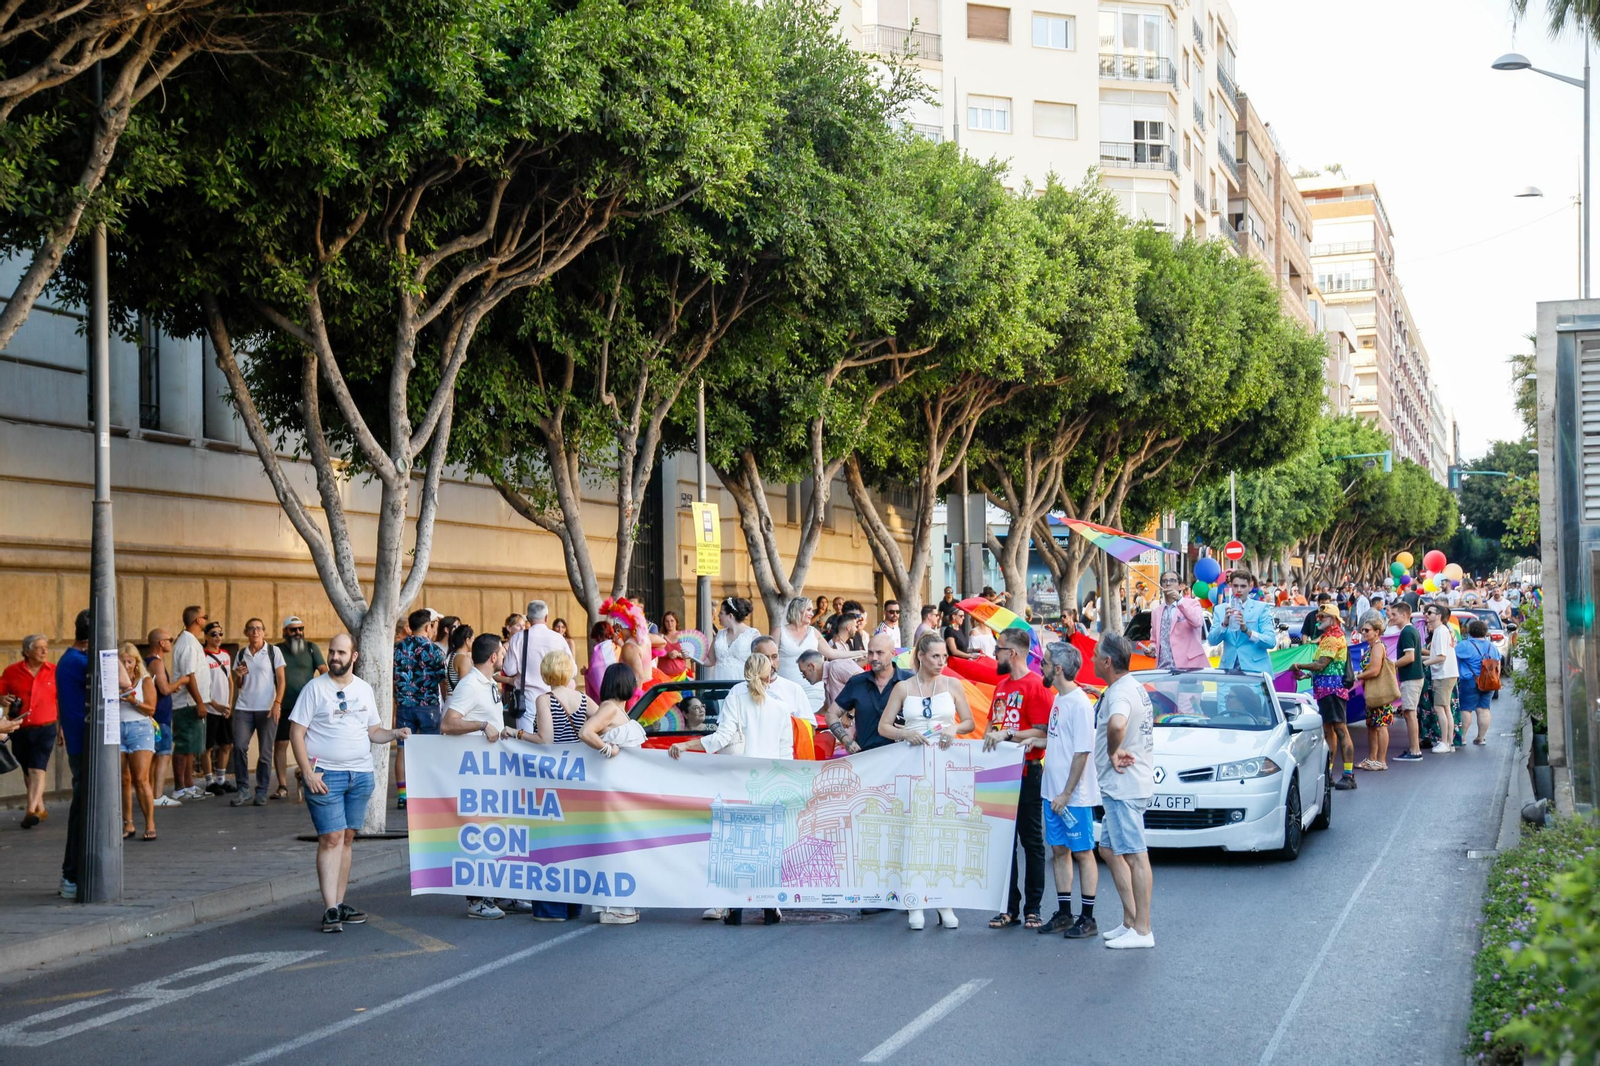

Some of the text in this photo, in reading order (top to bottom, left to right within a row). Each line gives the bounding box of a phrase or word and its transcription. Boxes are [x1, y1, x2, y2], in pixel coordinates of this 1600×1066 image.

[458, 750, 586, 781] ALMERÍA
[459, 788, 562, 818] BRILLA
[1166, 796, 1191, 809] GFP
[460, 825, 527, 854] CON
[455, 861, 636, 897] DIVERSIDAD
